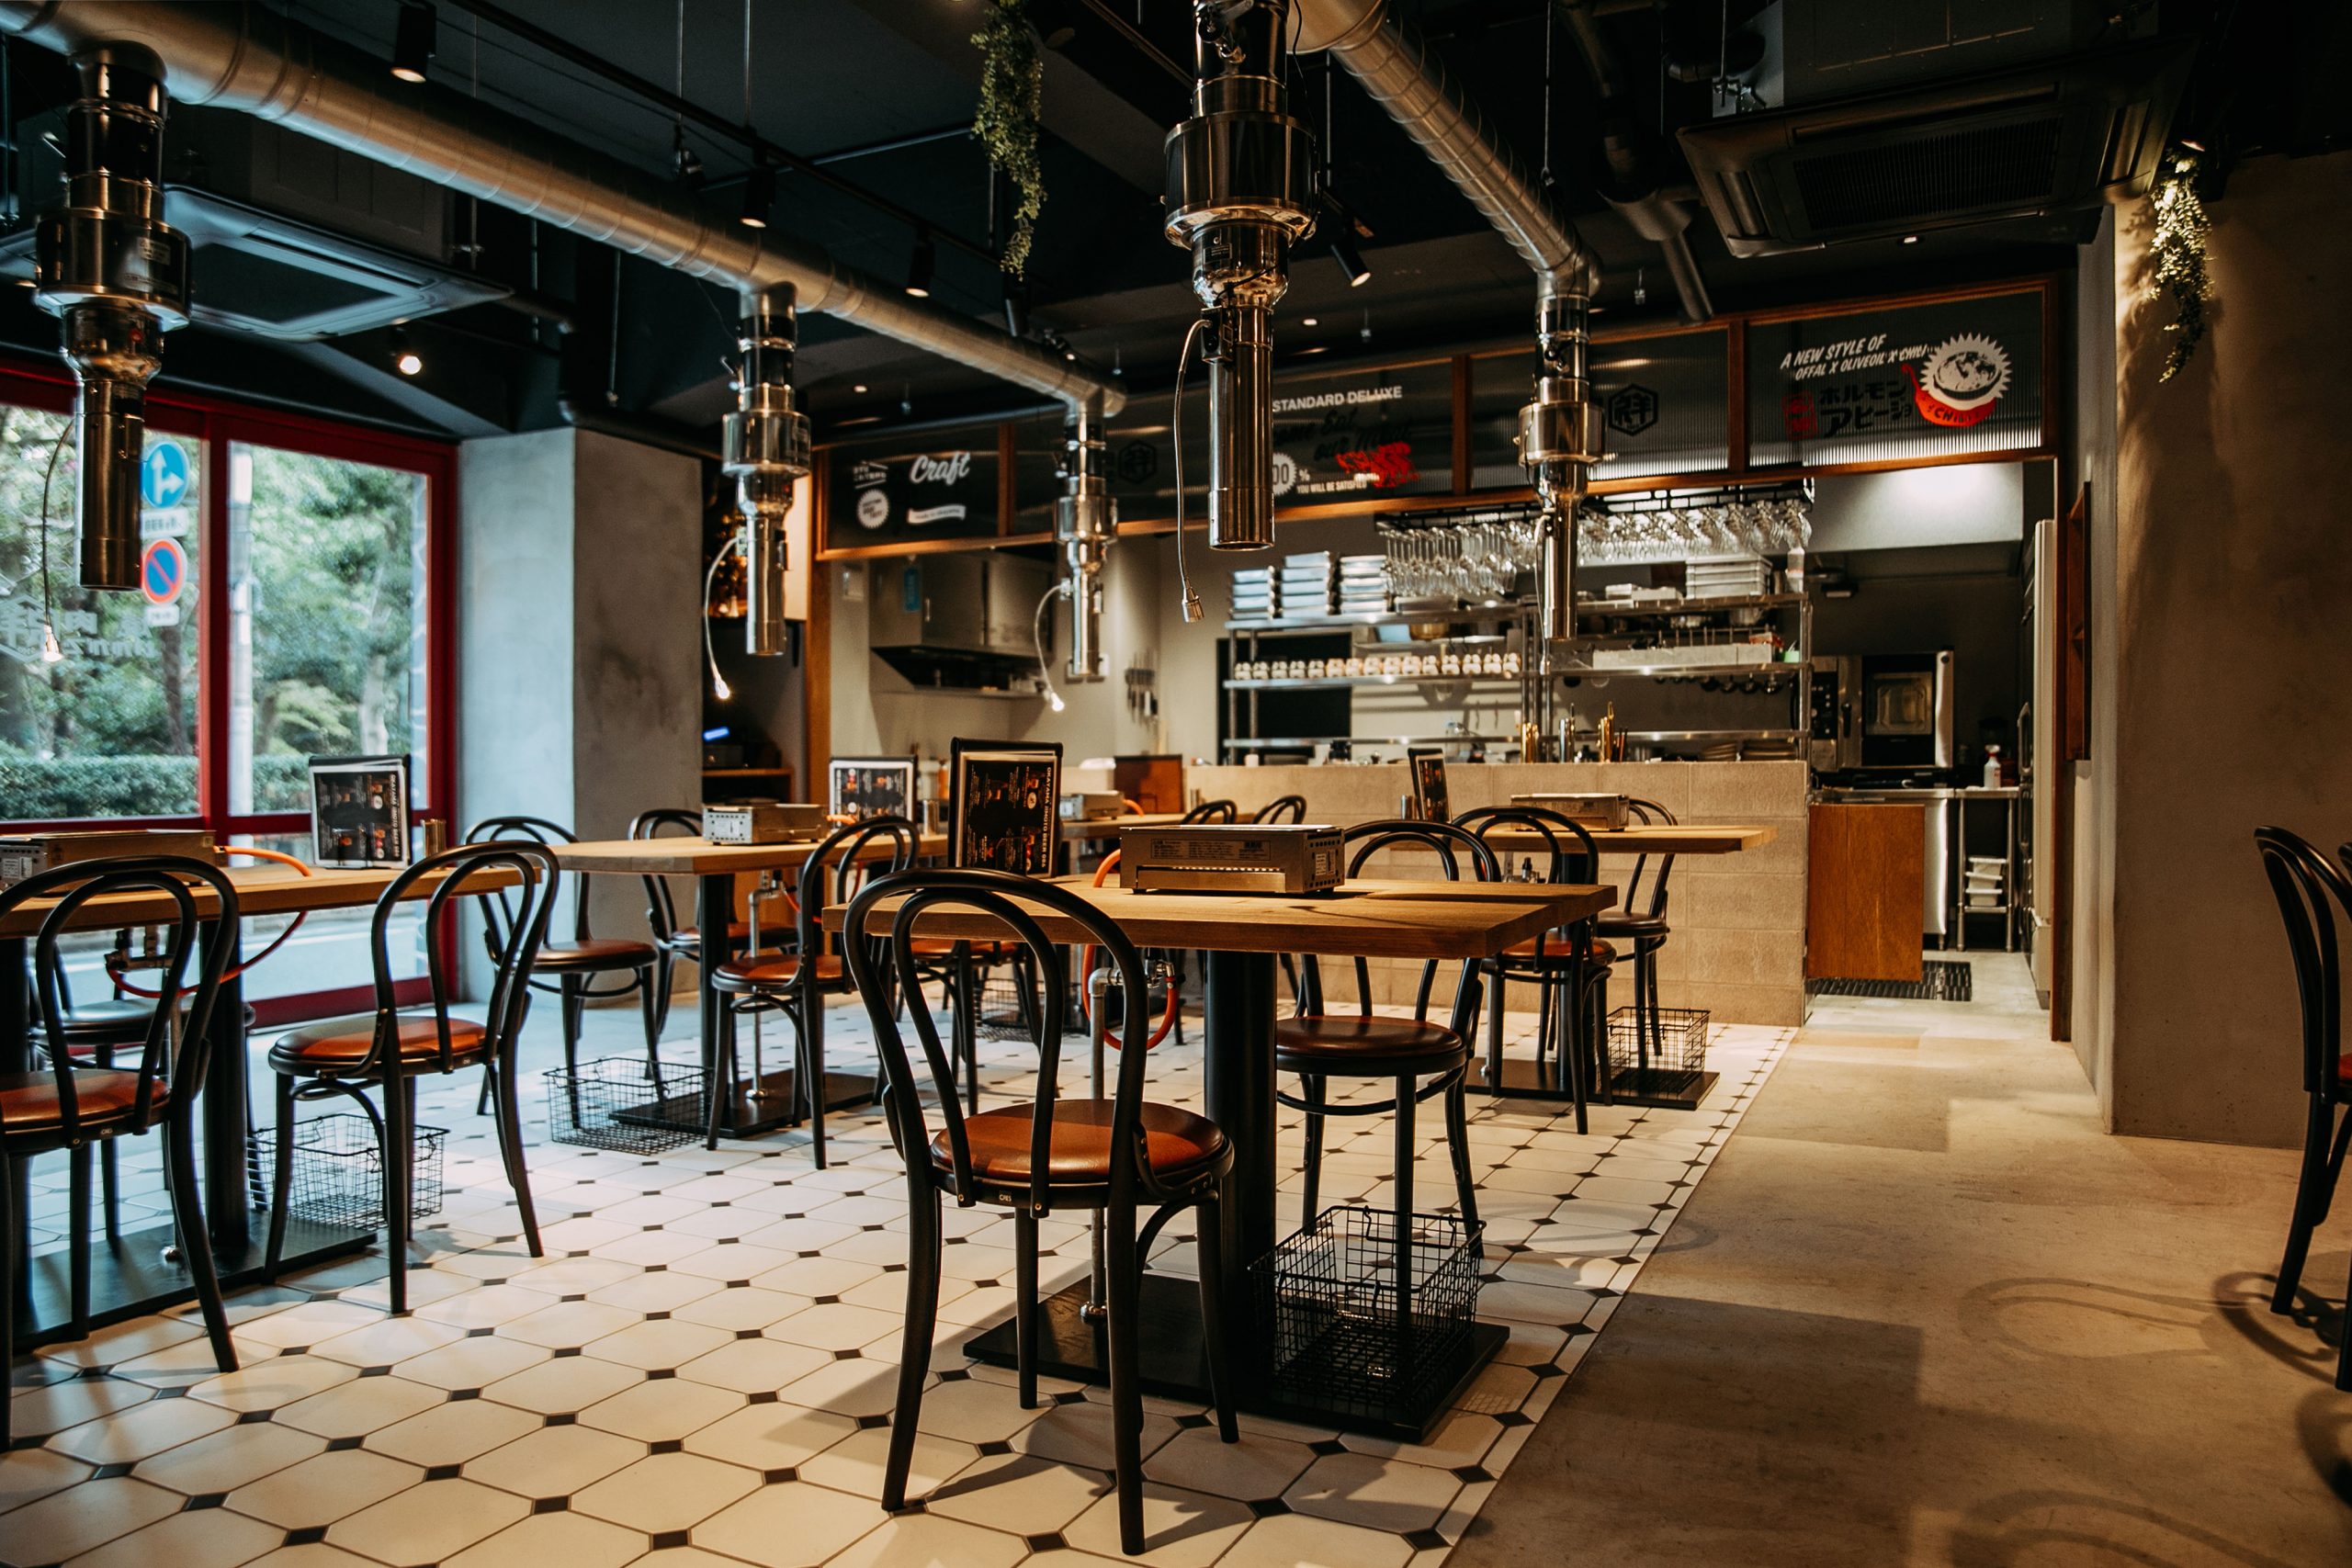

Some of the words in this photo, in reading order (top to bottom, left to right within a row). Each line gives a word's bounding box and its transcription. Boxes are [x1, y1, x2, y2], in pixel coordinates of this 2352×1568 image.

[1780, 352, 1792, 370] A
[1793, 346, 1825, 367] NEW
[1825, 338, 1866, 361] STYLE
[1867, 333, 1887, 353] OF
[1794, 363, 1826, 381] OFFAL
[1839, 352, 1884, 373] OLIVEOIL
[1272, 392, 1344, 412] STANDARD
[1346, 385, 1403, 404] DELUXE
[1820, 382, 1906, 404] ホルモン
[910, 451, 971, 486] Craft
[1296, 484, 1309, 494] YOU
[1310, 482, 1326, 493] WILL
